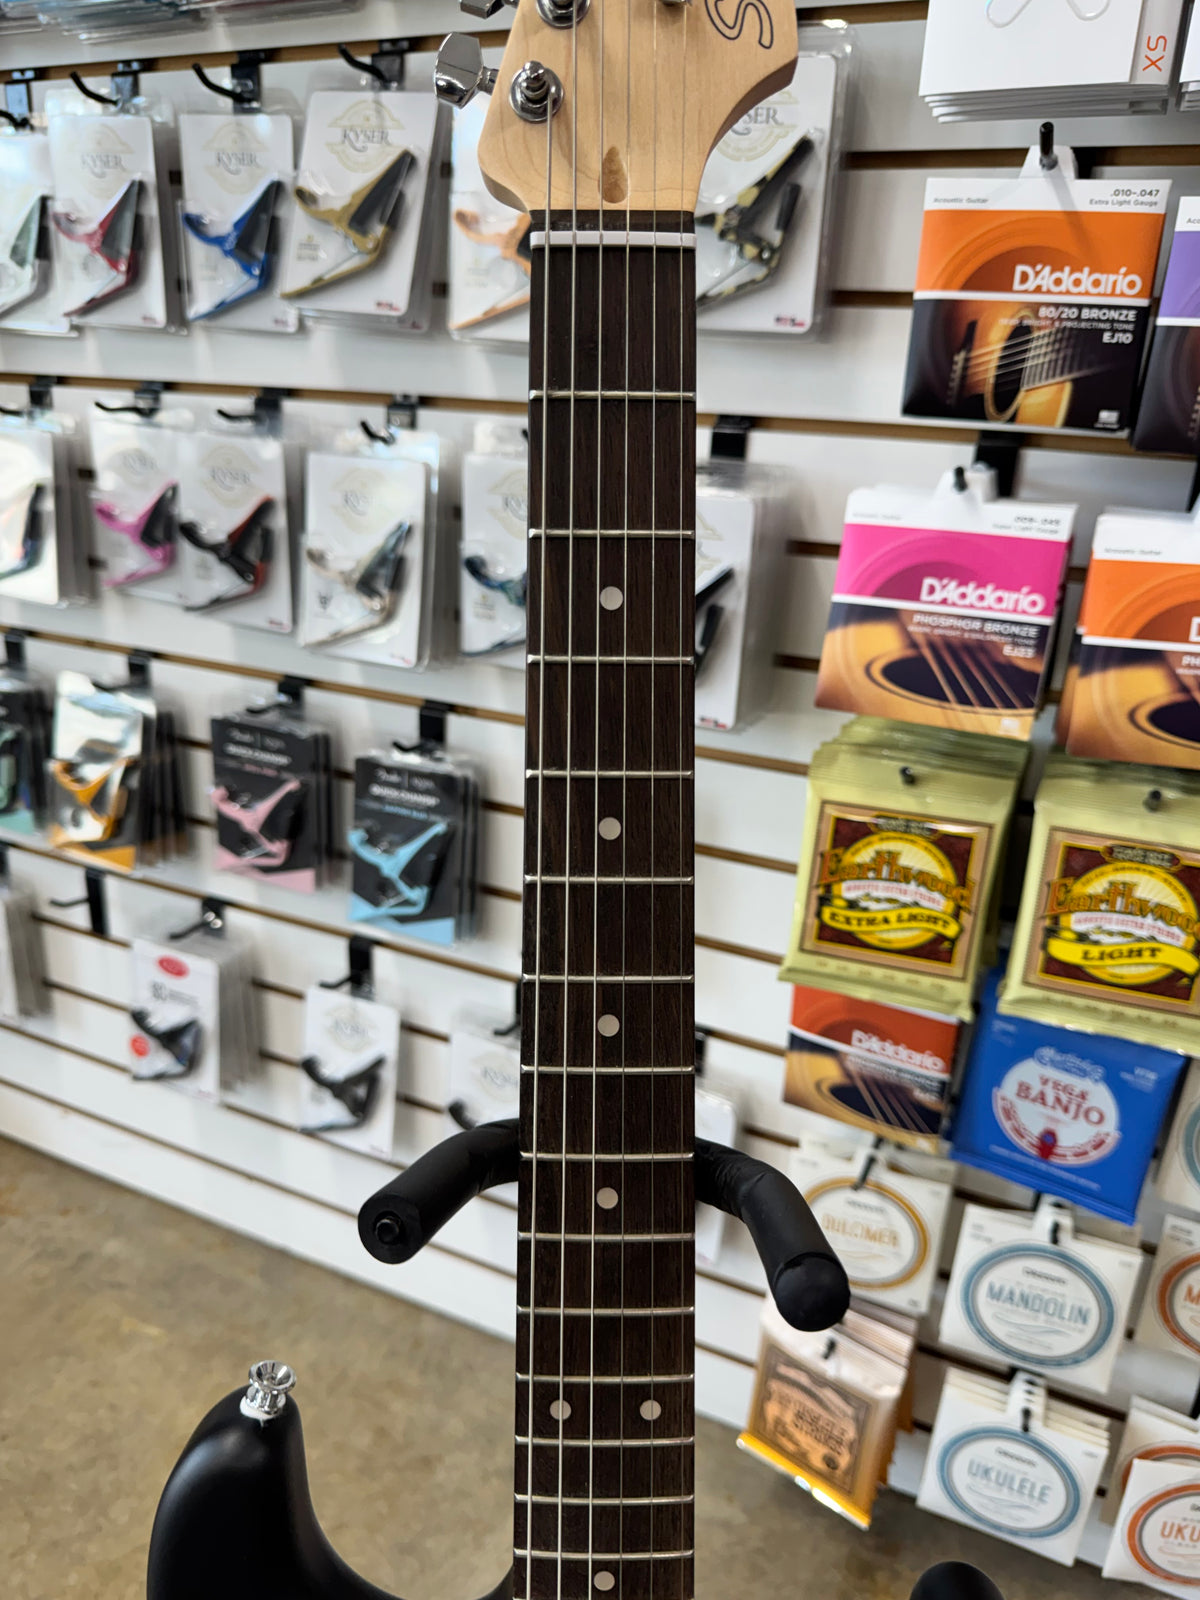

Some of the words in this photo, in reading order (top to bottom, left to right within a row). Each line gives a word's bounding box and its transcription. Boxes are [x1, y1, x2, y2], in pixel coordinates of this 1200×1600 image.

[1142, 35, 1168, 72] XS
[342, 128, 393, 153] KYSER
[81, 153, 128, 178] KYSER
[215, 151, 262, 176] KYSER
[1089, 198, 1109, 206] Extra
[1111, 199, 1132, 207] Light
[1133, 200, 1158, 208] Gauge
[1038, 305, 1078, 319] 80/20
[1080, 307, 1137, 321] BRONZE
[1102, 332, 1133, 344] EJ10
[912, 613, 983, 632] PHOSPHOR
[983, 621, 1040, 638] BRONZE
[818, 847, 974, 914] Earthwood
[1045, 875, 1200, 938] Earthwoo
[829, 911, 890, 927] EXTRA
[896, 911, 950, 929] LIGHT
[1081, 947, 1162, 961] LIGHT
[1038, 1073, 1089, 1101] VEGA
[1016, 1081, 1106, 1126] BANJO
[986, 1280, 1091, 1325] MANDOLIN
[967, 1457, 1052, 1504] UKULELE
